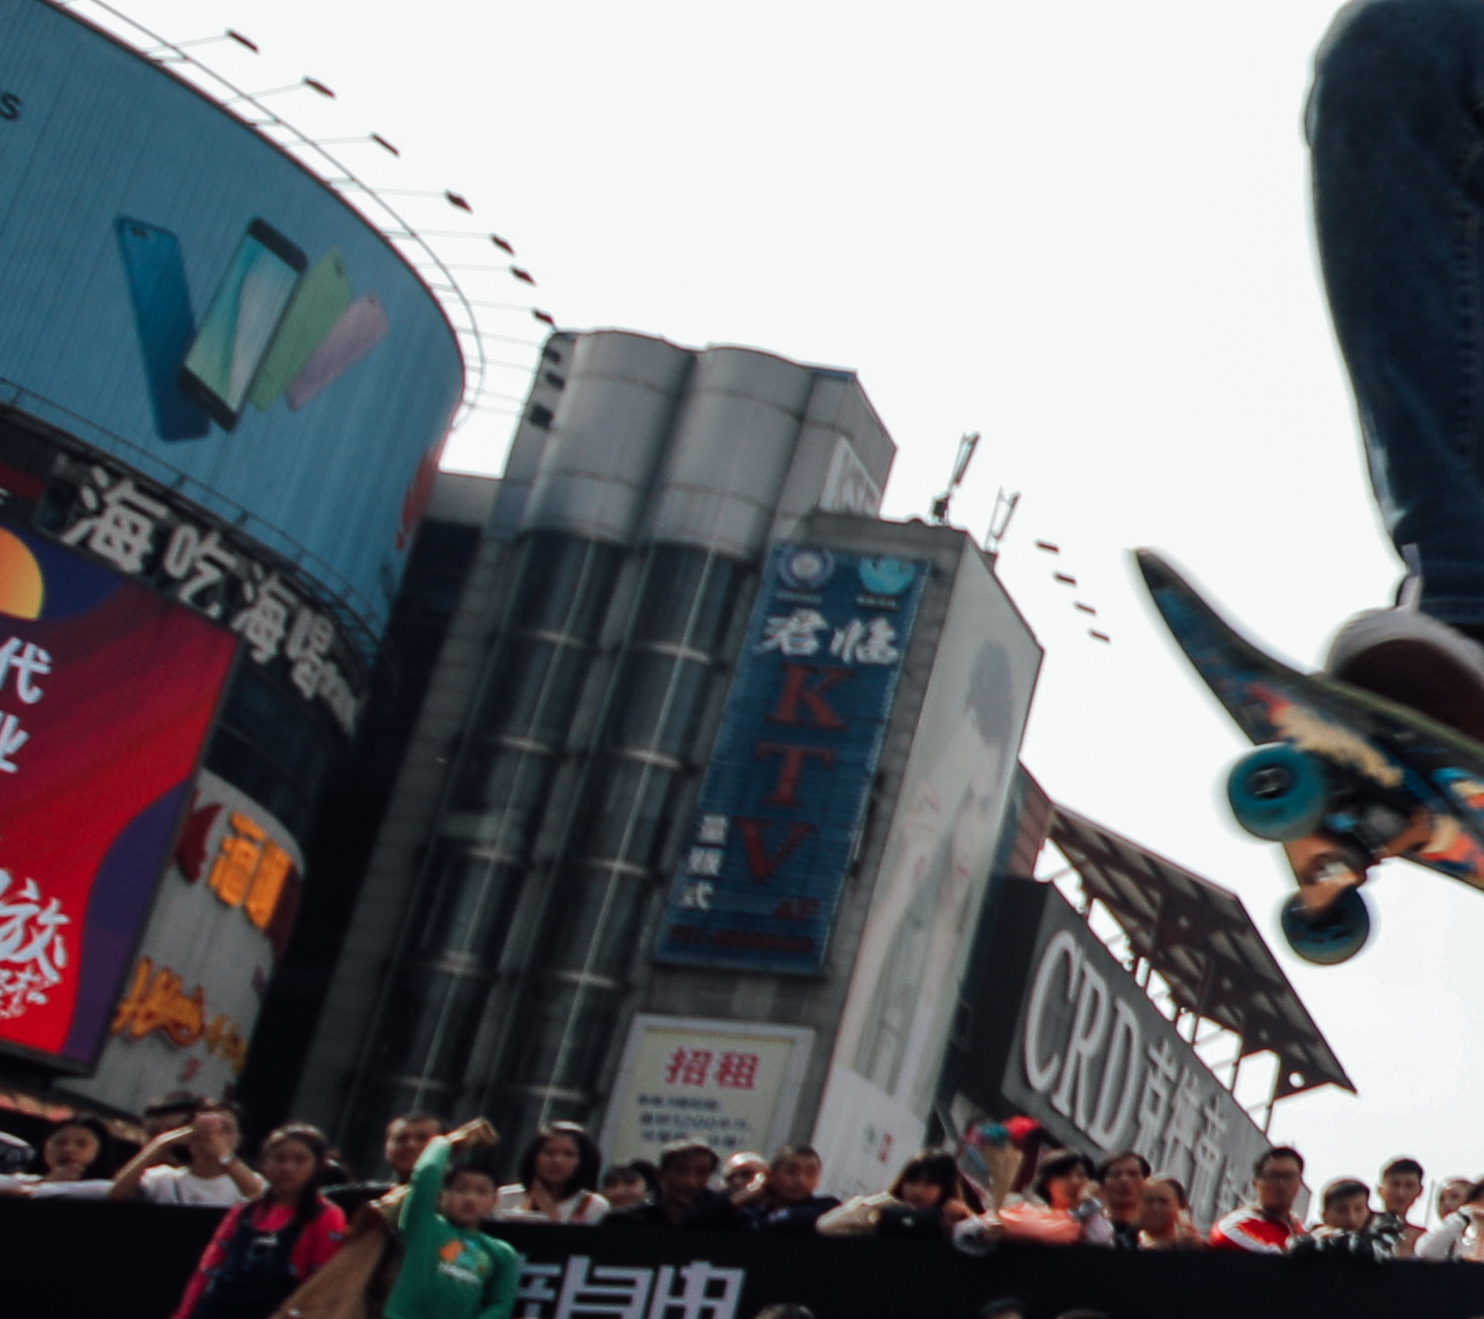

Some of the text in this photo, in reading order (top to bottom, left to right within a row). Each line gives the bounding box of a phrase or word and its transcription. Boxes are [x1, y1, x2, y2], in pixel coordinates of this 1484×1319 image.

[747, 606, 900, 666] 君临
[732, 662, 857, 882] KTV
[664, 1046, 760, 1091] 招租
[1024, 930, 1142, 1152] CRD
